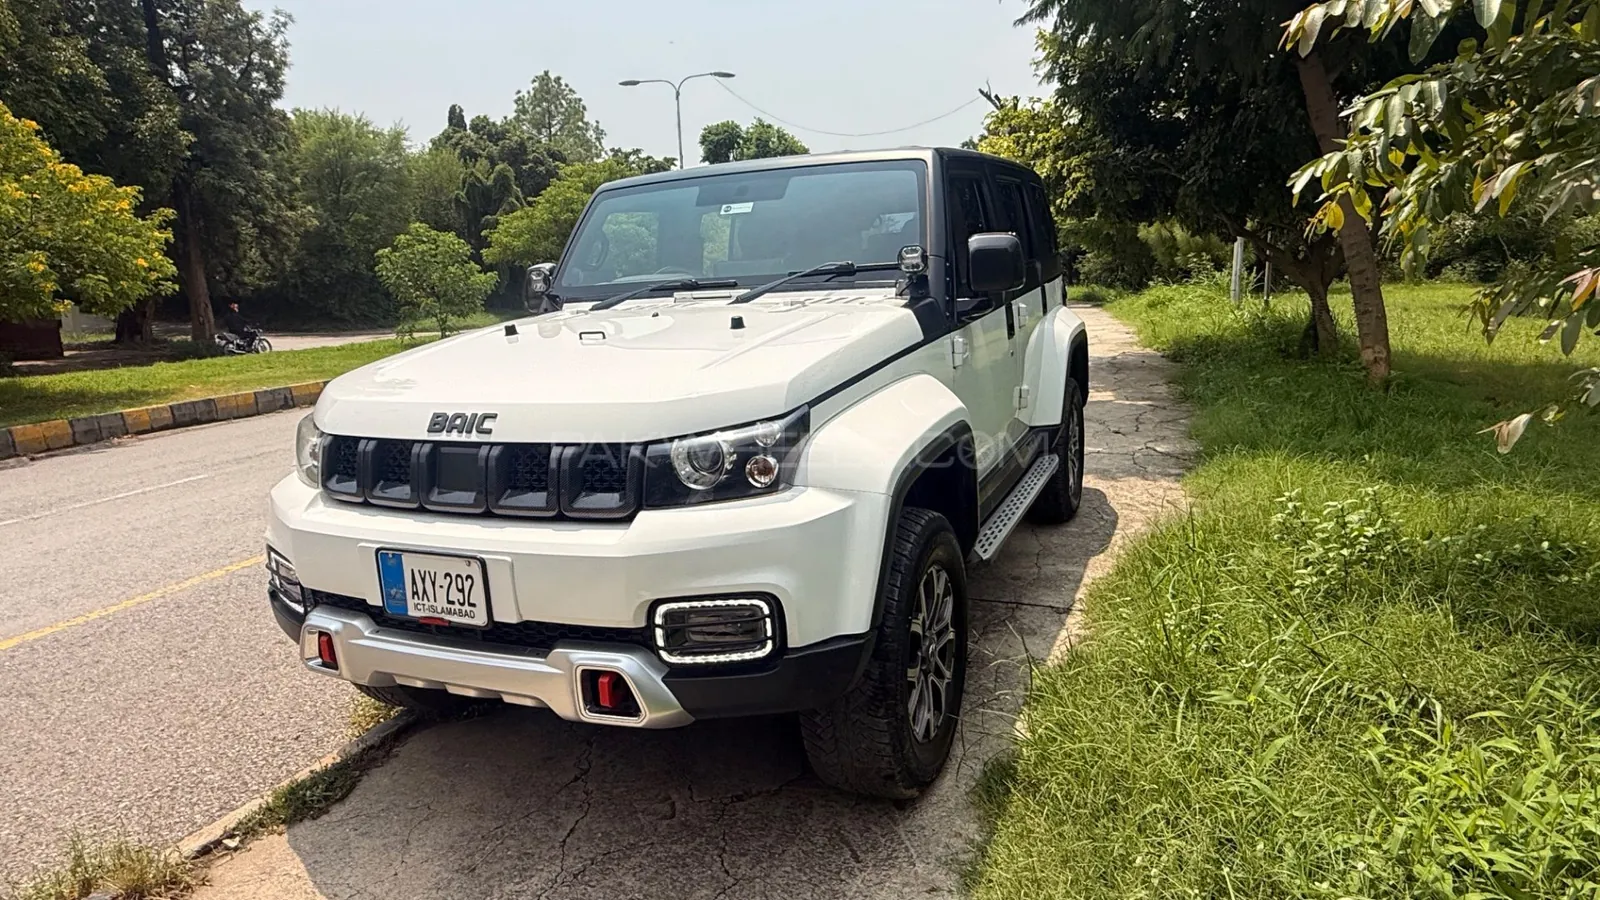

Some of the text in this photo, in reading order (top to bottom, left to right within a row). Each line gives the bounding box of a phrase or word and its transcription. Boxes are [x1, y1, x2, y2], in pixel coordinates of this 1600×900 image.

[427, 412, 498, 434] BAIC
[411, 568, 477, 608] AXY-292
[413, 602, 476, 619] ICT-ISLAMABAD
